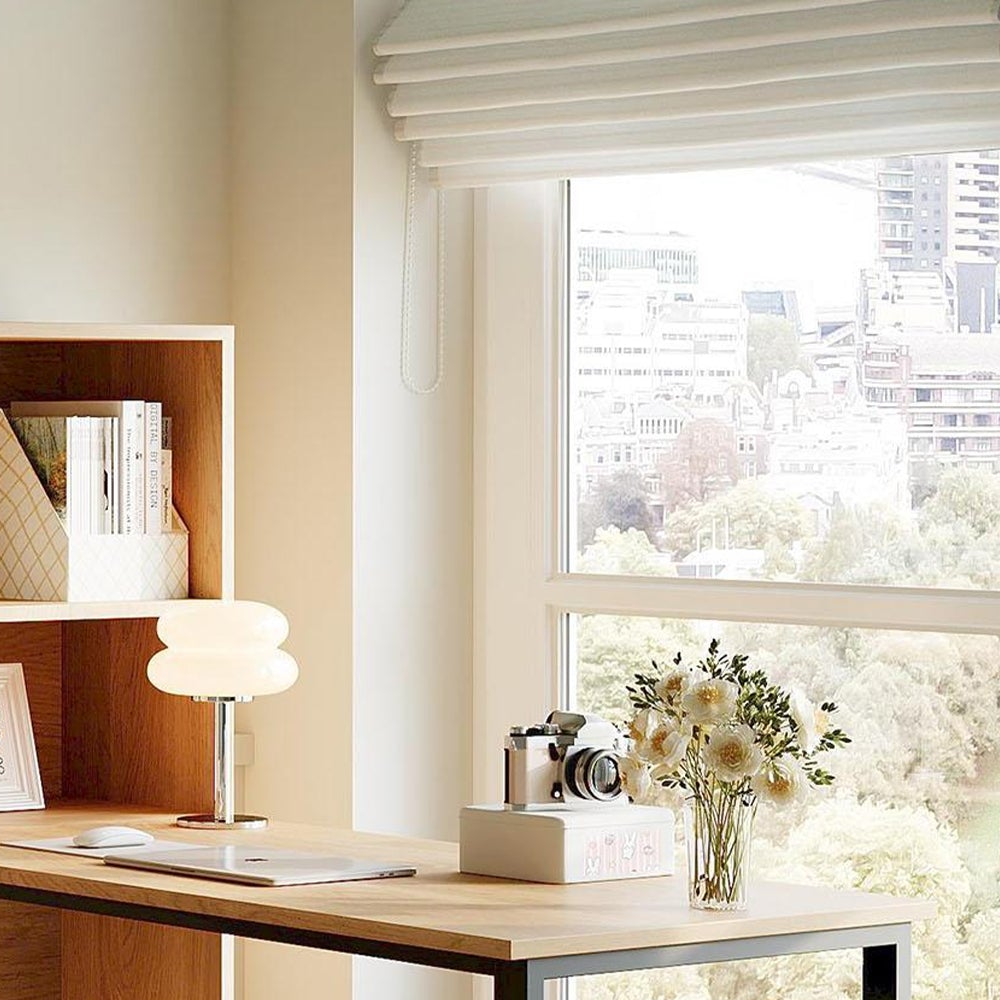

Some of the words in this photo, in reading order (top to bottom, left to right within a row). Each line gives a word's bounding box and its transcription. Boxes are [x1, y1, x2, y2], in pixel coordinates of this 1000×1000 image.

[150, 404, 158, 445] DIGITAL
[150, 451, 158, 464] BY
[150, 470, 158, 509] DESIGN
